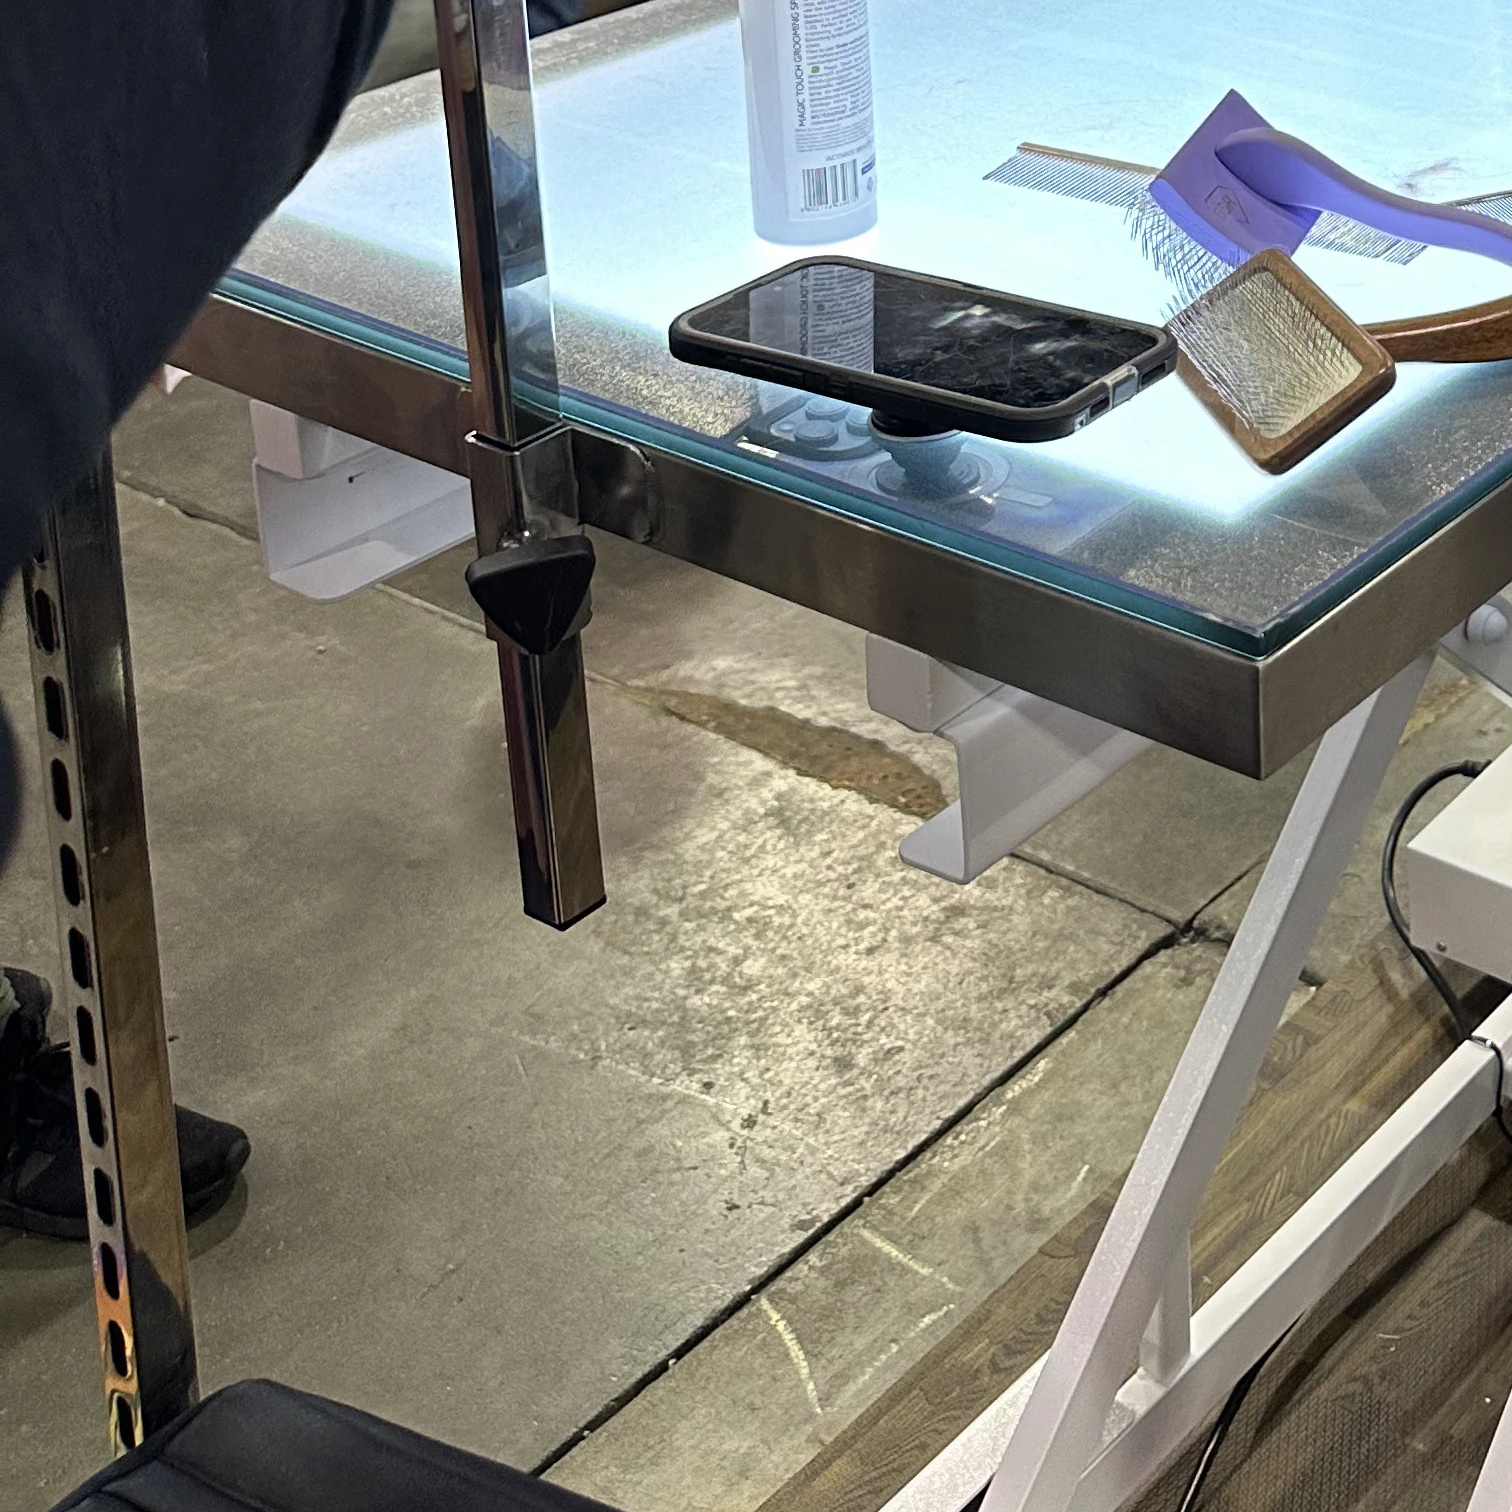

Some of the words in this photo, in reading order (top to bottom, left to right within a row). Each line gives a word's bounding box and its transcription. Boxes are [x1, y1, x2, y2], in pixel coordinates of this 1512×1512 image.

[791, 13, 803, 62] GROOMING
[795, 65, 804, 96] TOUCH
[797, 98, 805, 126] MAGIC
